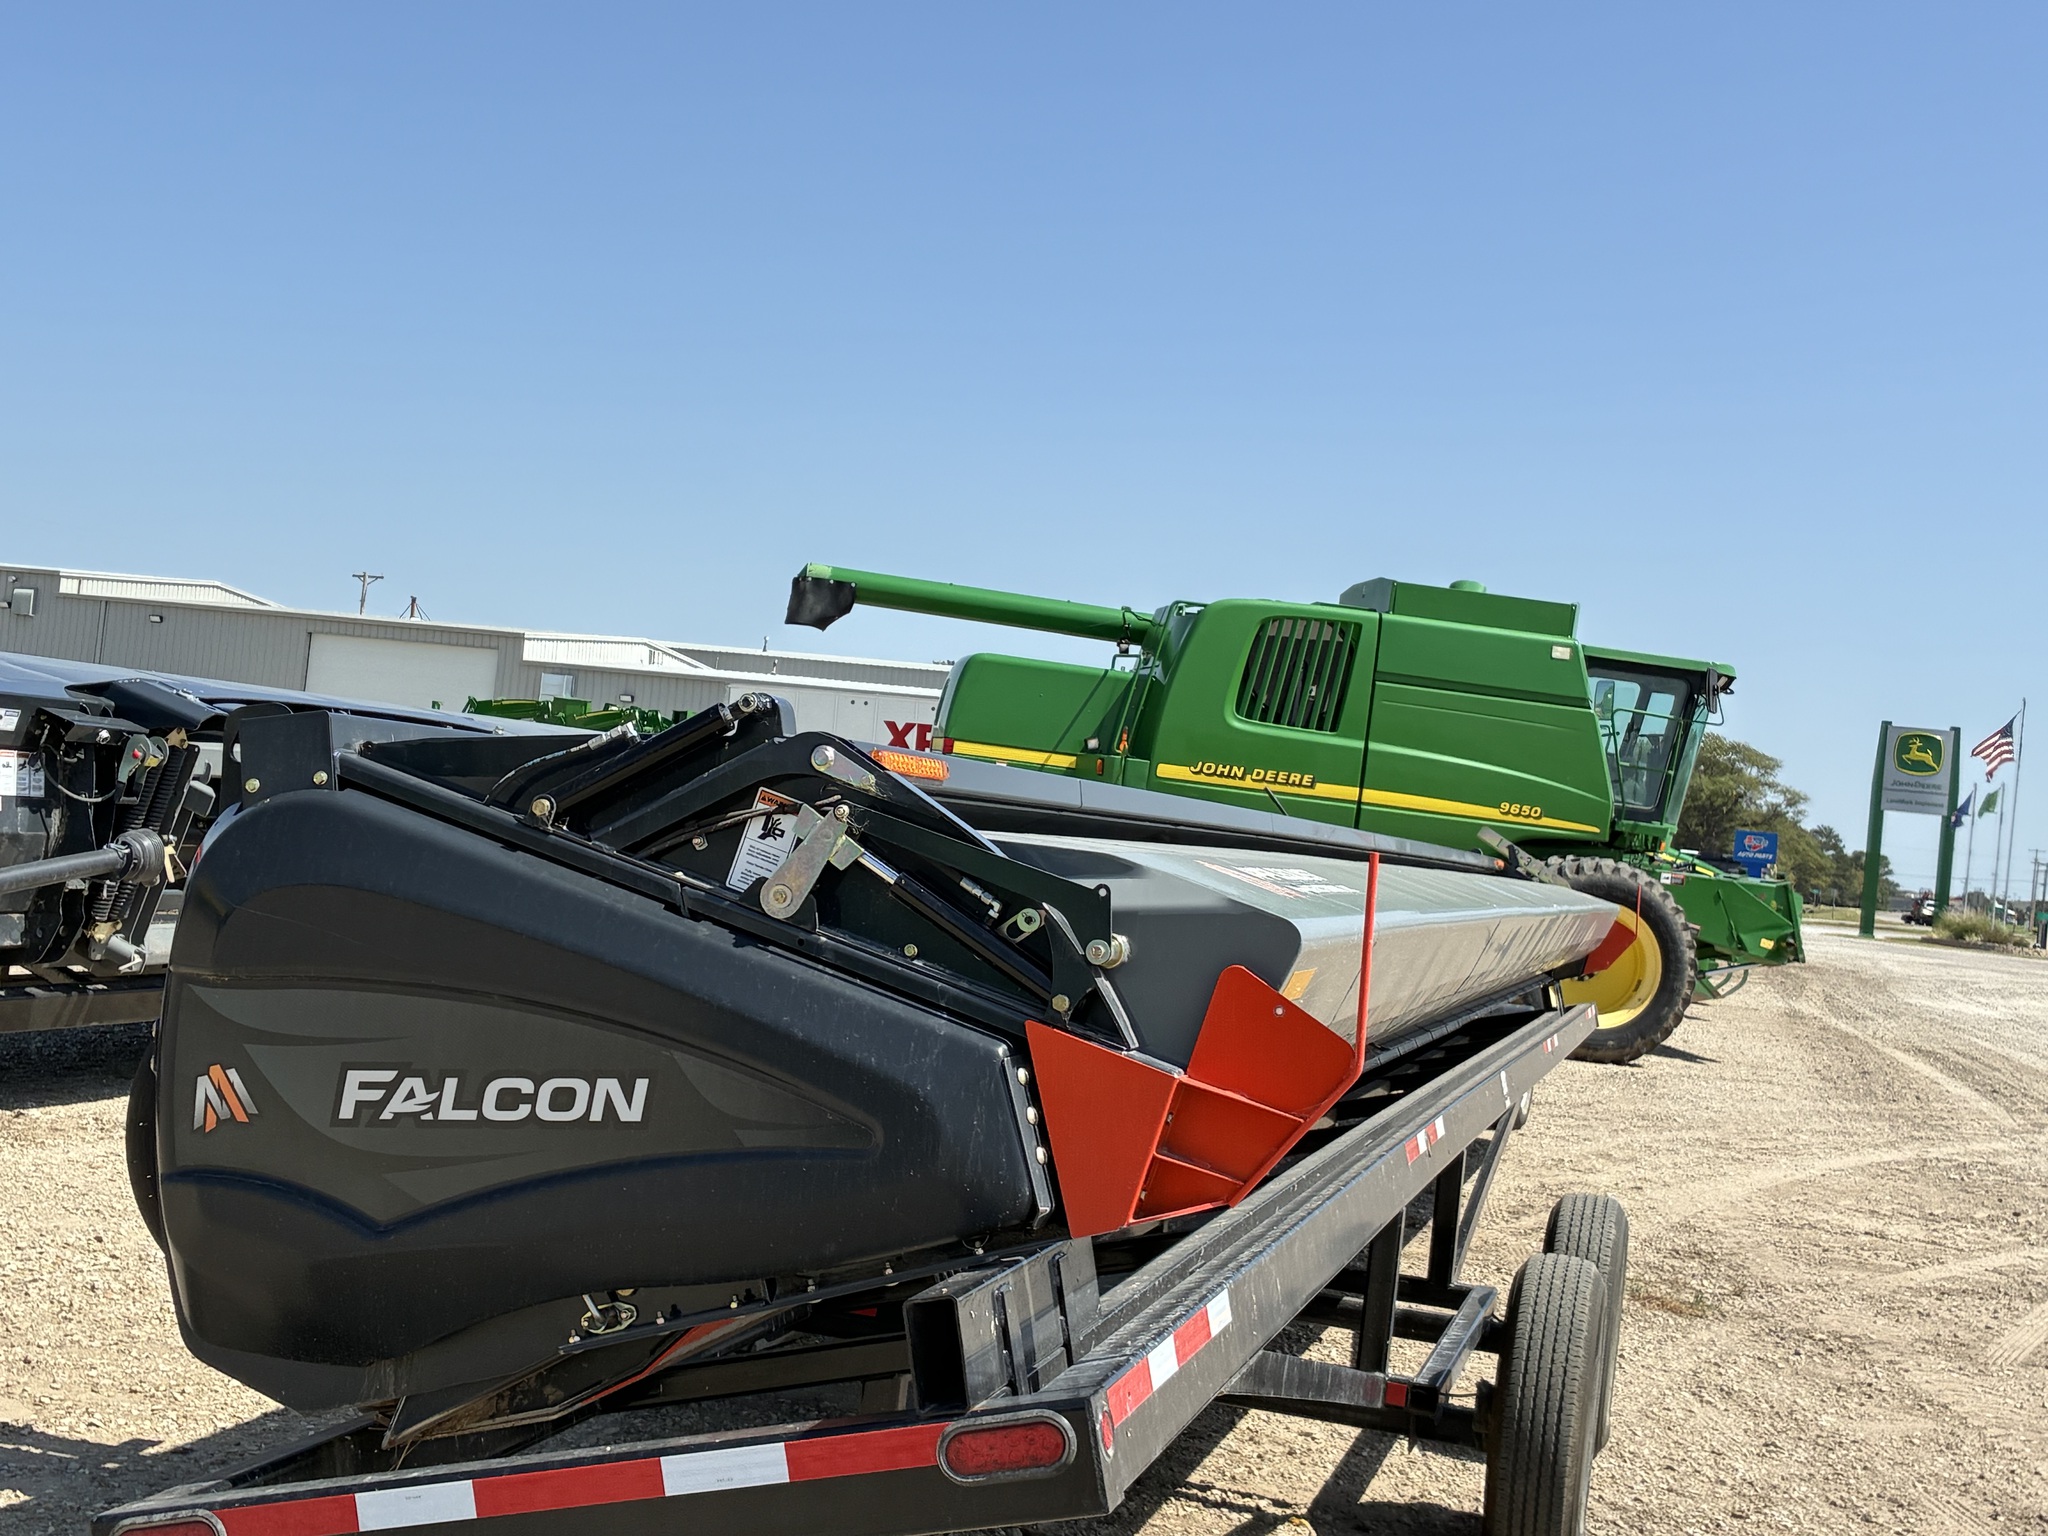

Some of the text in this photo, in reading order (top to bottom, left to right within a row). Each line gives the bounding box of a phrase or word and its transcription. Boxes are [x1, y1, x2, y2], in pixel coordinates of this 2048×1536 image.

[1189, 761, 1315, 788] JOHN DEERE
[1499, 801, 1542, 819] 9650
[337, 1069, 650, 1123] FALCON
